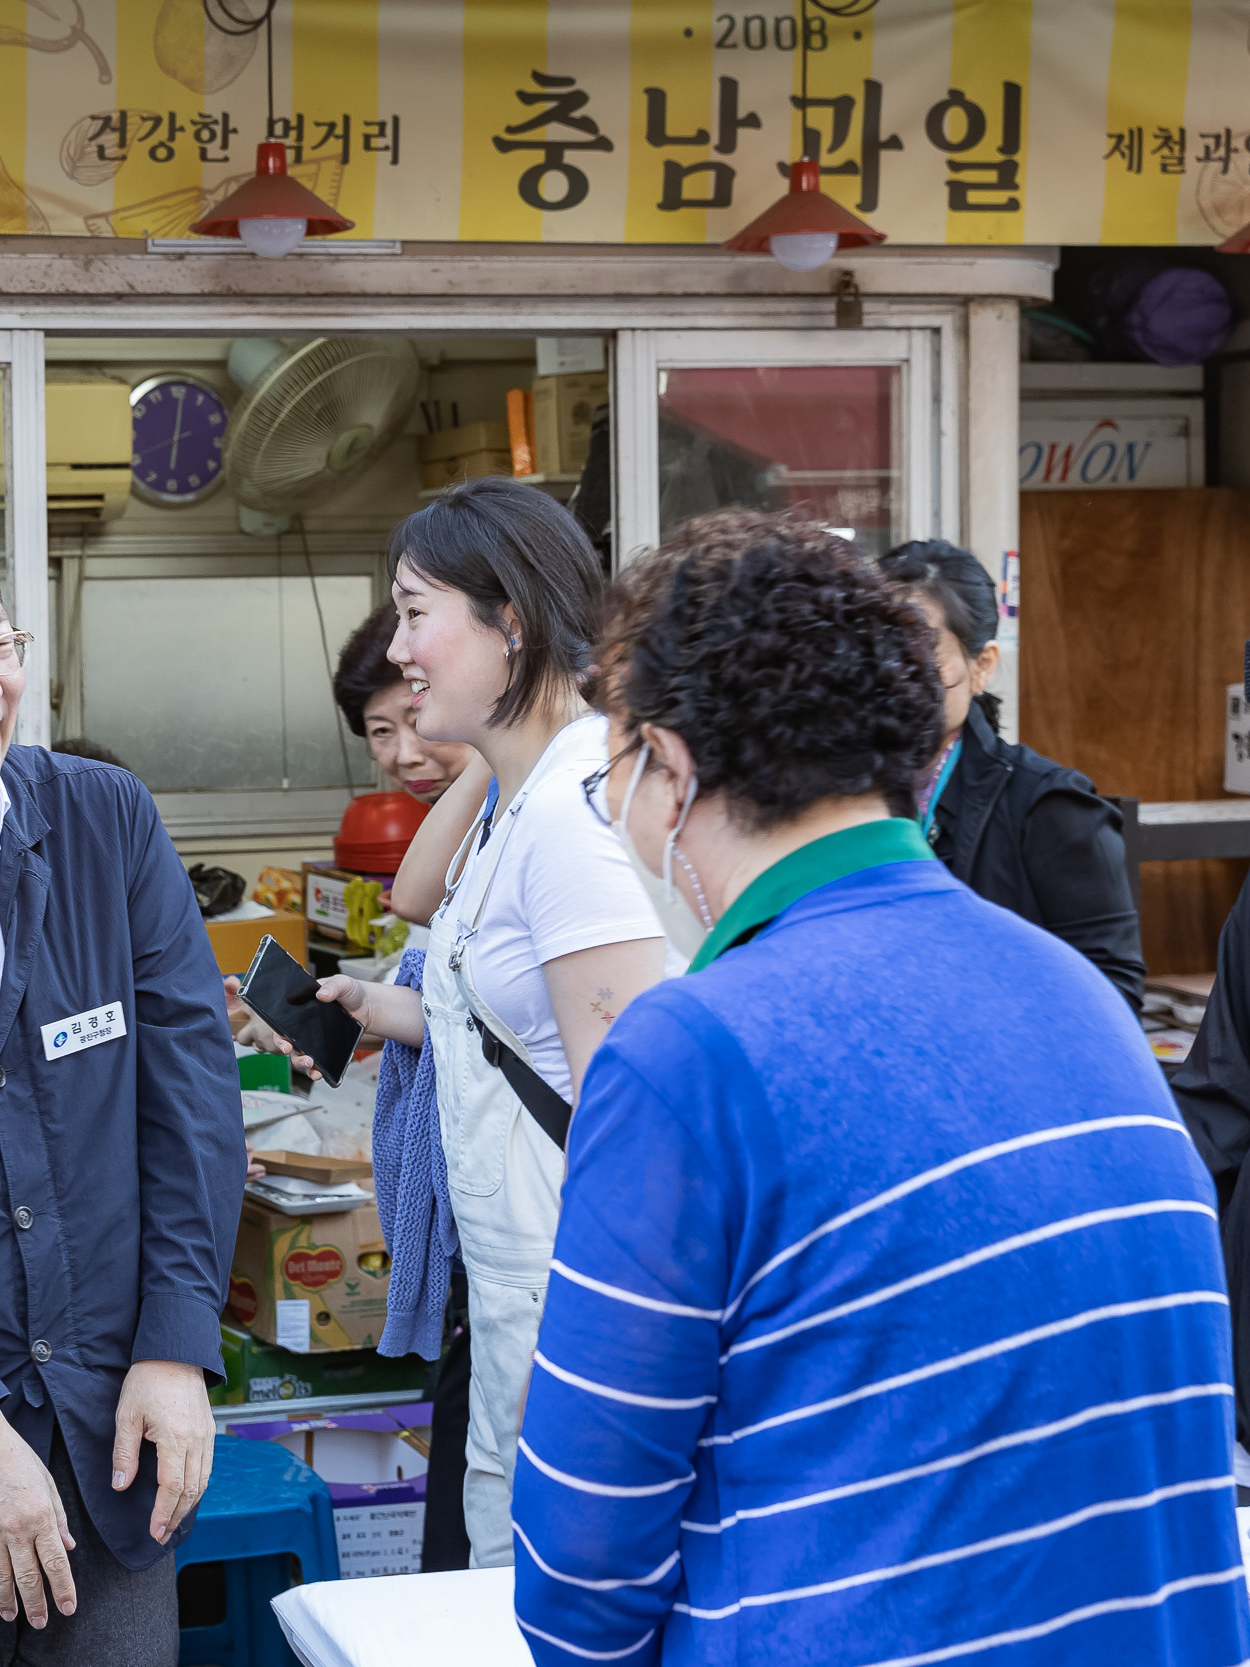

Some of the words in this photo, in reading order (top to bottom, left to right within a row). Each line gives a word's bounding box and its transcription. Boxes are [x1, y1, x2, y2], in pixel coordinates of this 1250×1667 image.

[714, 13, 829, 52] 2008
[87, 109, 239, 164] 건강한
[267, 112, 400, 166] 먹거리
[492, 68, 1024, 213] 충남과일
[1103, 125, 1250, 176] 제철과
